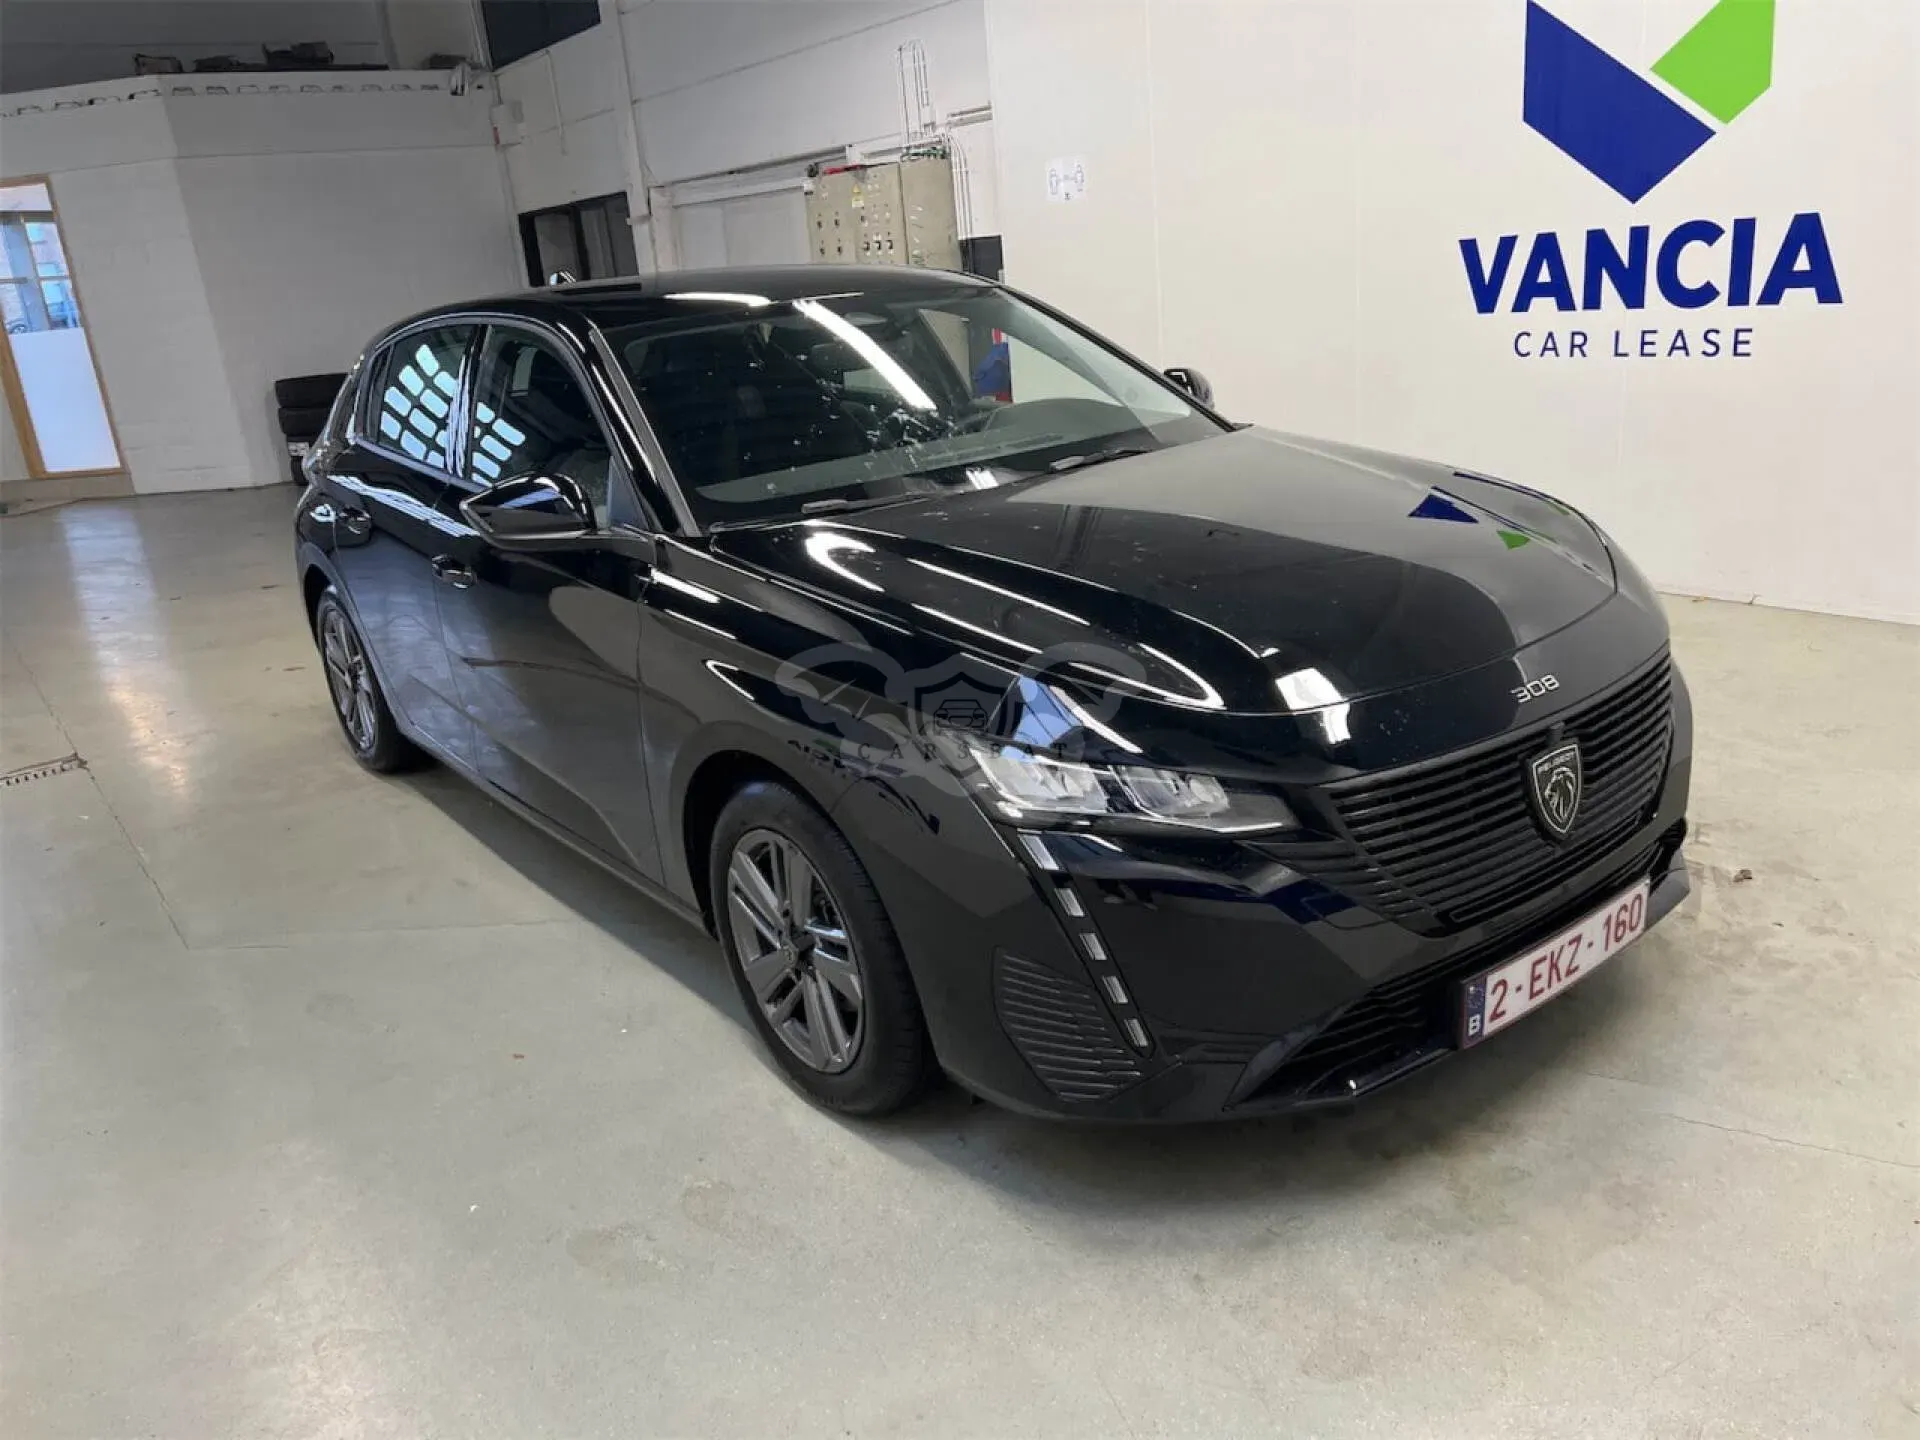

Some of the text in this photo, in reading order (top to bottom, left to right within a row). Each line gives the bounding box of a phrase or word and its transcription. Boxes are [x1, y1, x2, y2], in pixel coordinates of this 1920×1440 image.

[1459, 212, 1843, 314] VANCIA
[1514, 328, 1753, 358] CAR LEASE
[1511, 674, 1560, 703] 308
[1488, 893, 1643, 1023] 2-EKZ-160
[1468, 1014, 1481, 1036] B
